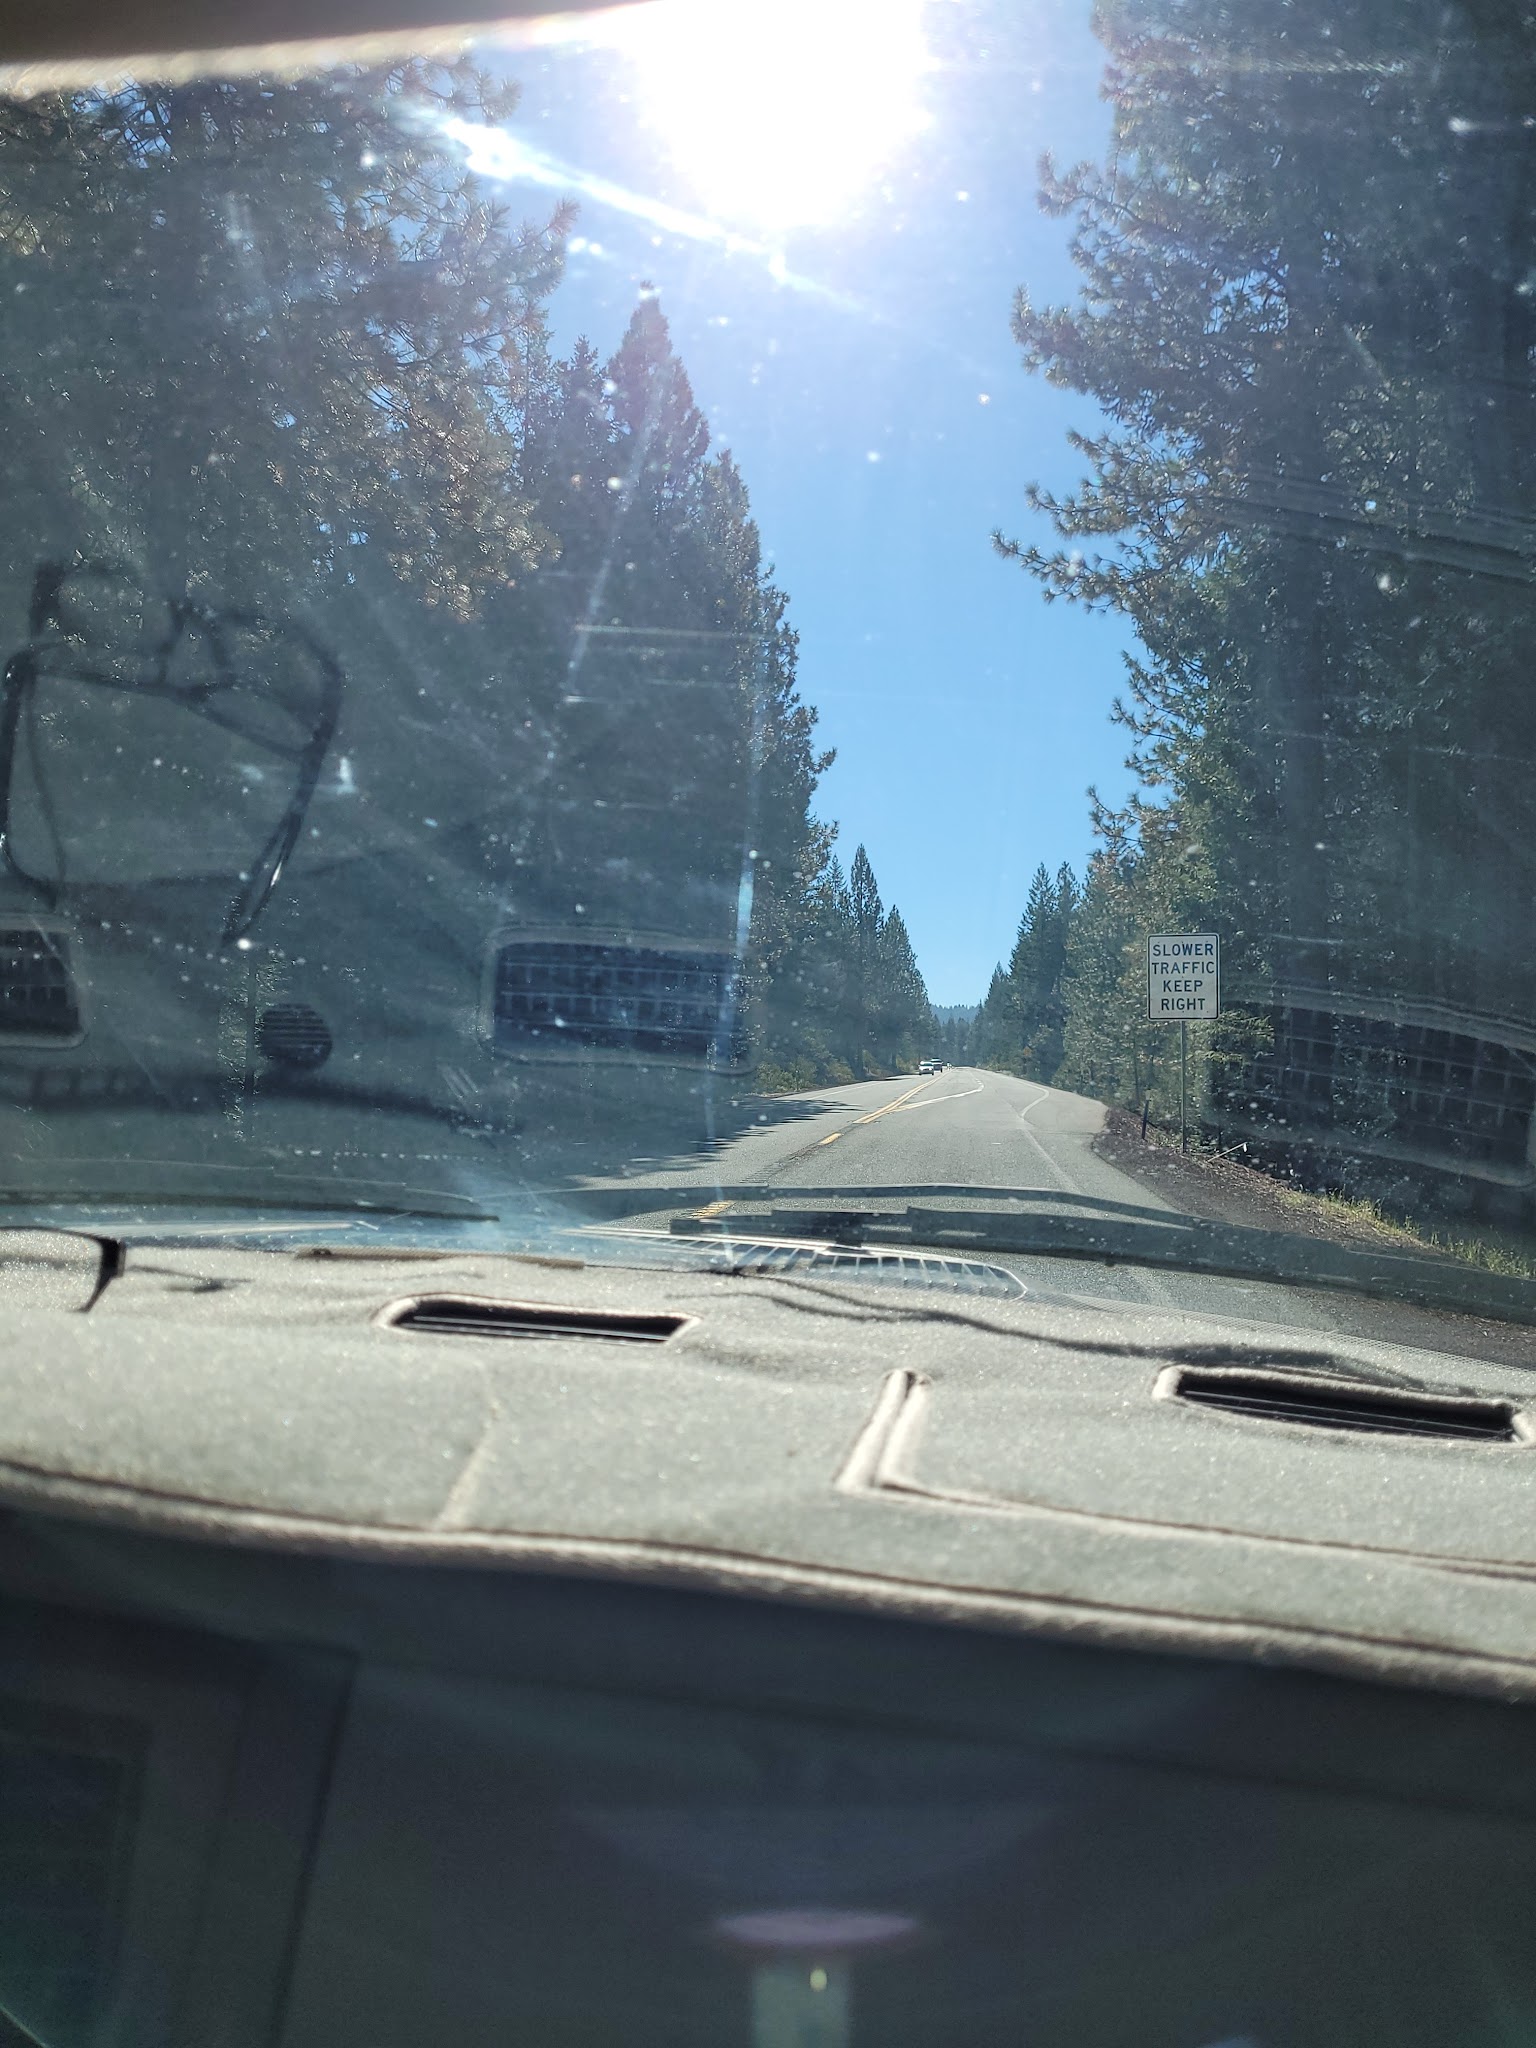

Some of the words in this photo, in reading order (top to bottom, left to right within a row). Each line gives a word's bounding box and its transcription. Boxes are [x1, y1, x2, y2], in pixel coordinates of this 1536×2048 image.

[1153, 943, 1214, 956] SLOWER
[1151, 961, 1215, 974] TRAFFIC
[1163, 980, 1203, 992] KEEP
[1161, 998, 1206, 1011] RIGHT
